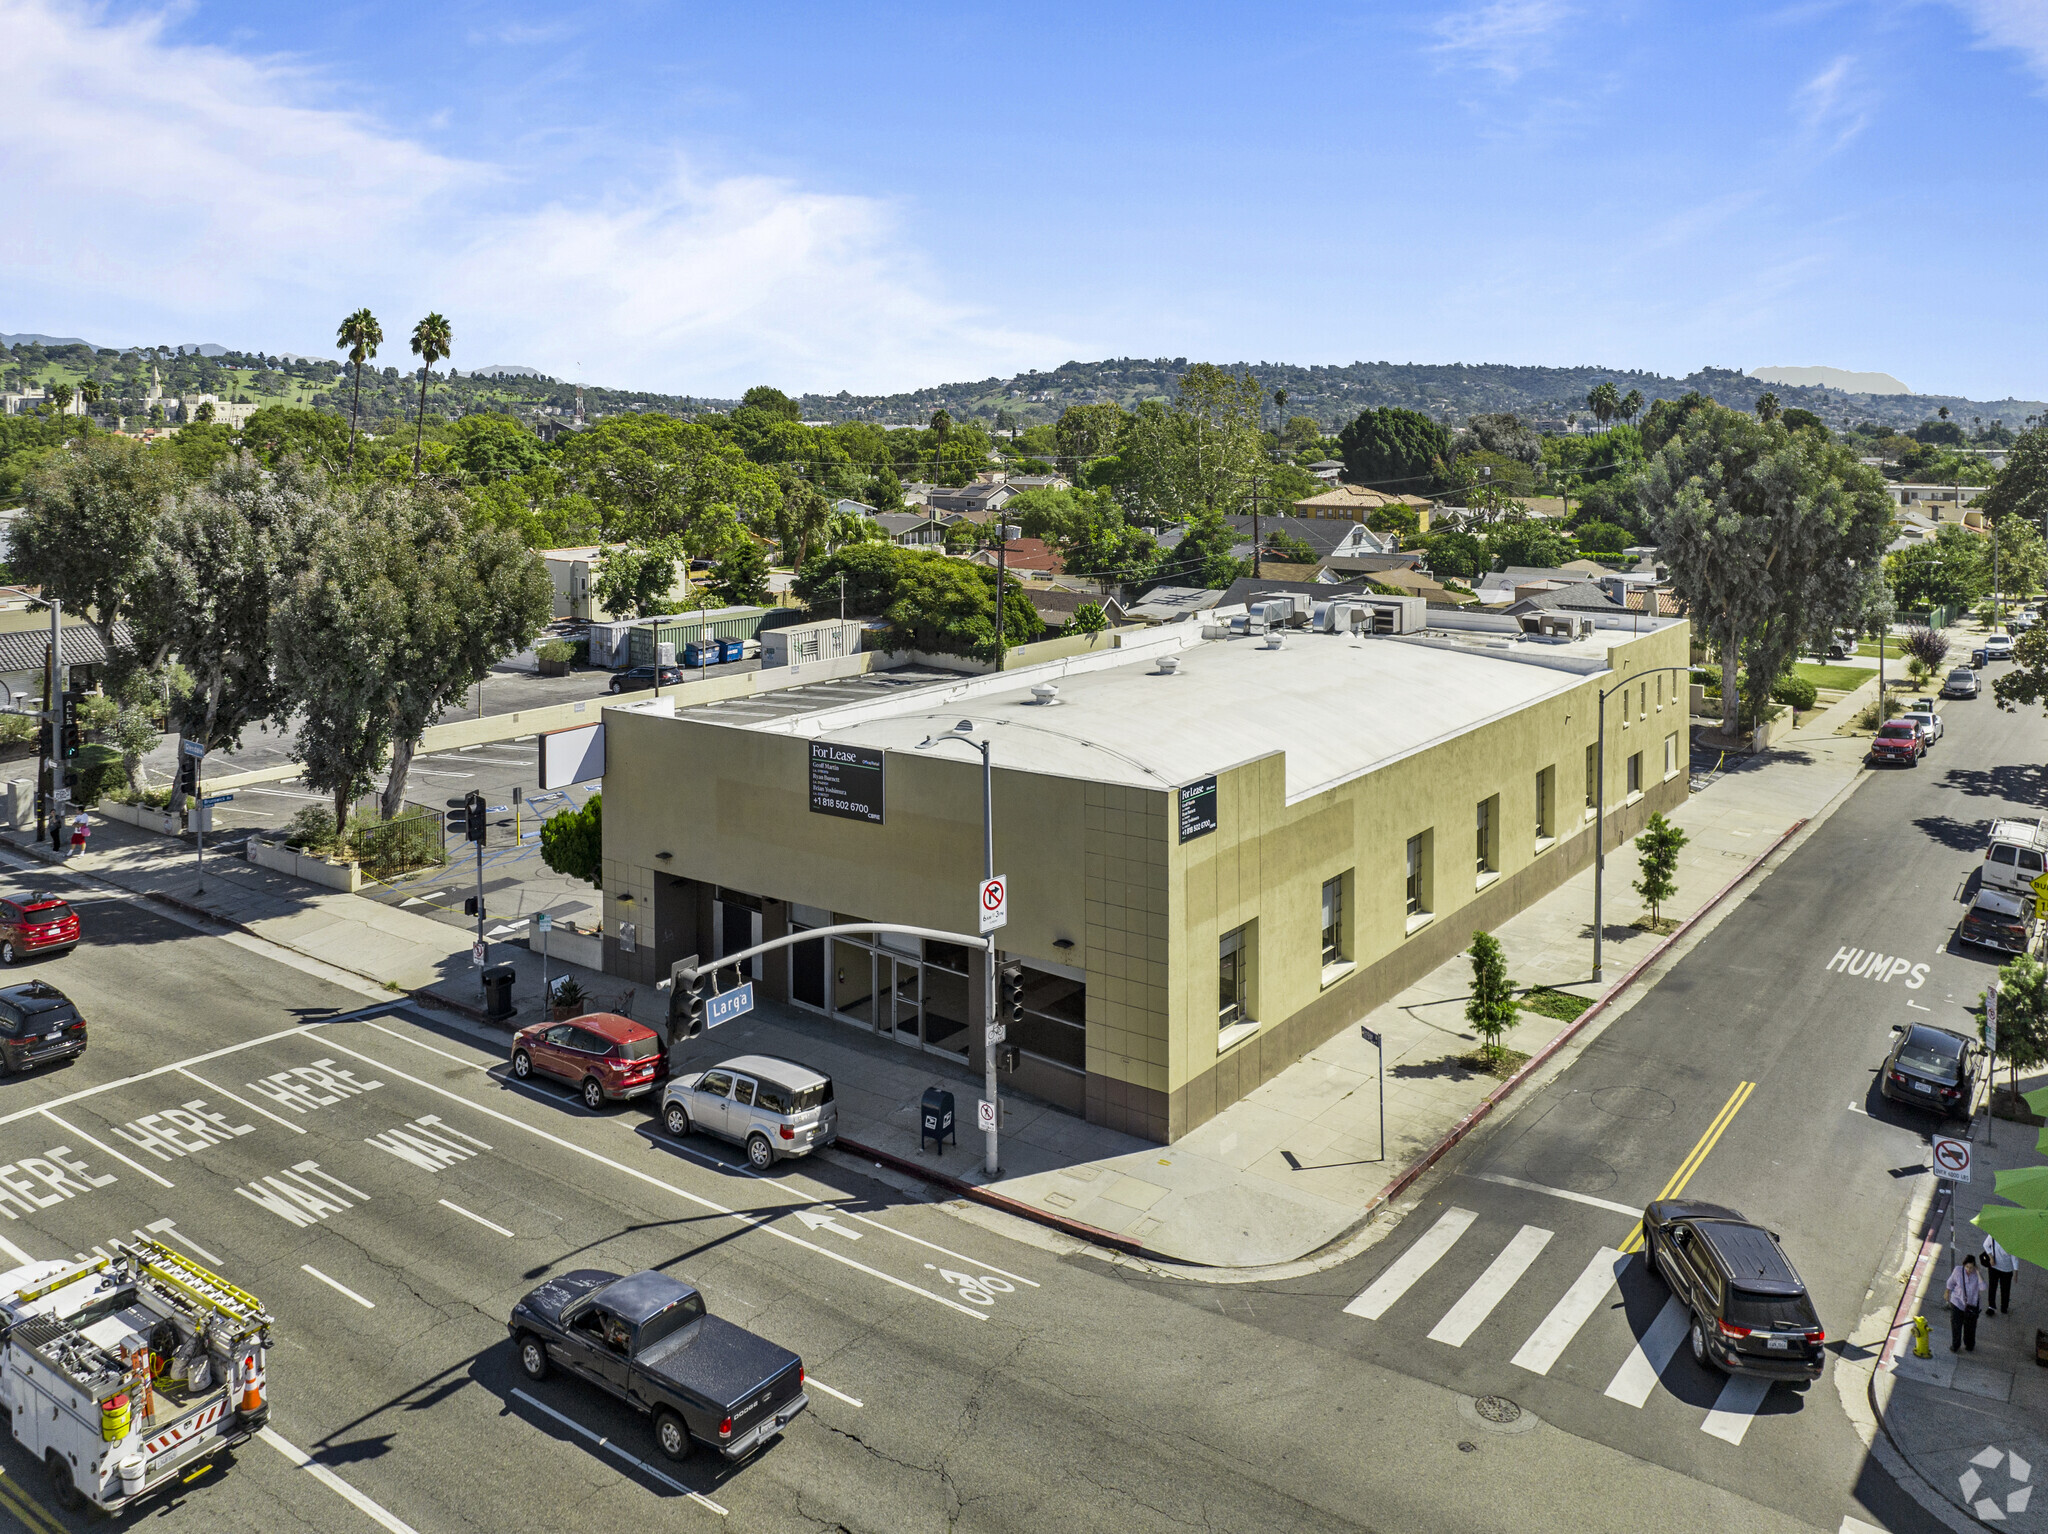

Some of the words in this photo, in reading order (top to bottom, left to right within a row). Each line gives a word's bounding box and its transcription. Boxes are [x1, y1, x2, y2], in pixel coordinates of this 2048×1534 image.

[812, 744, 828, 759] For
[829, 747, 857, 762] Lease
[1182, 789, 1190, 799] For
[1190, 786, 1204, 797] Lease
[814, 797, 821, 806] +1
[822, 798, 835, 808] 818
[835, 800, 849, 810] 502
[850, 802, 869, 814] 6700
[2034, 881, 2048, 892] BU
[1825, 946, 1931, 989] HUMPS
[713, 994, 747, 1017] Larga
[246, 1058, 384, 1114] HERE
[110, 1099, 256, 1162] HERE
[363, 1114, 493, 1173] WAIT
[233, 1159, 372, 1228] WAIT
[733, 1400, 759, 1421] DODGE
